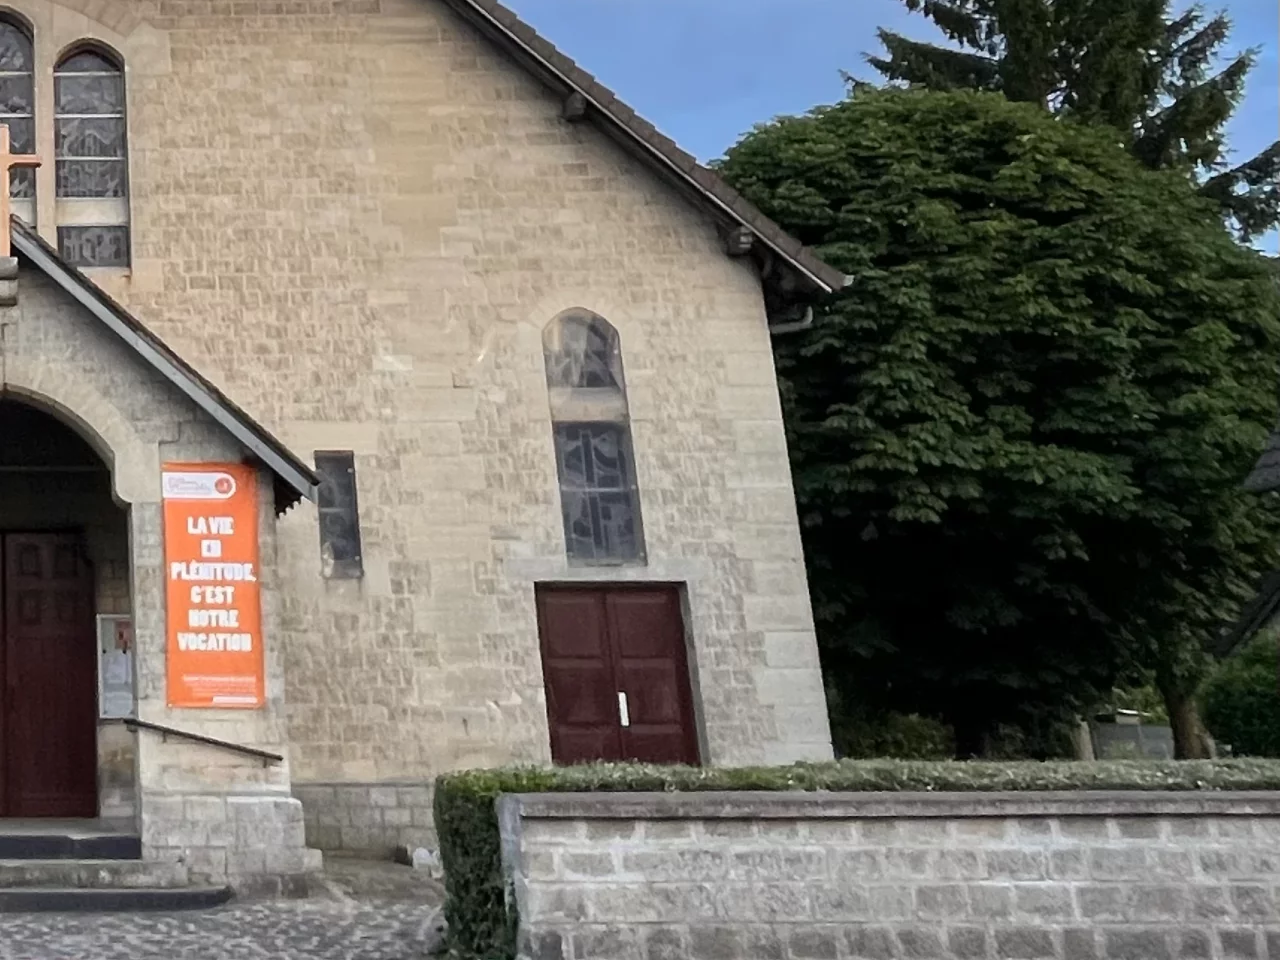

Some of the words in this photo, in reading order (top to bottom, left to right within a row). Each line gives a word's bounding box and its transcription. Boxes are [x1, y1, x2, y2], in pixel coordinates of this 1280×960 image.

[187, 516, 208, 534] LA
[208, 516, 234, 534] VIE
[191, 585, 235, 604] C'EST
[189, 609, 239, 628] NOTRE
[177, 632, 252, 651] VOCATION
